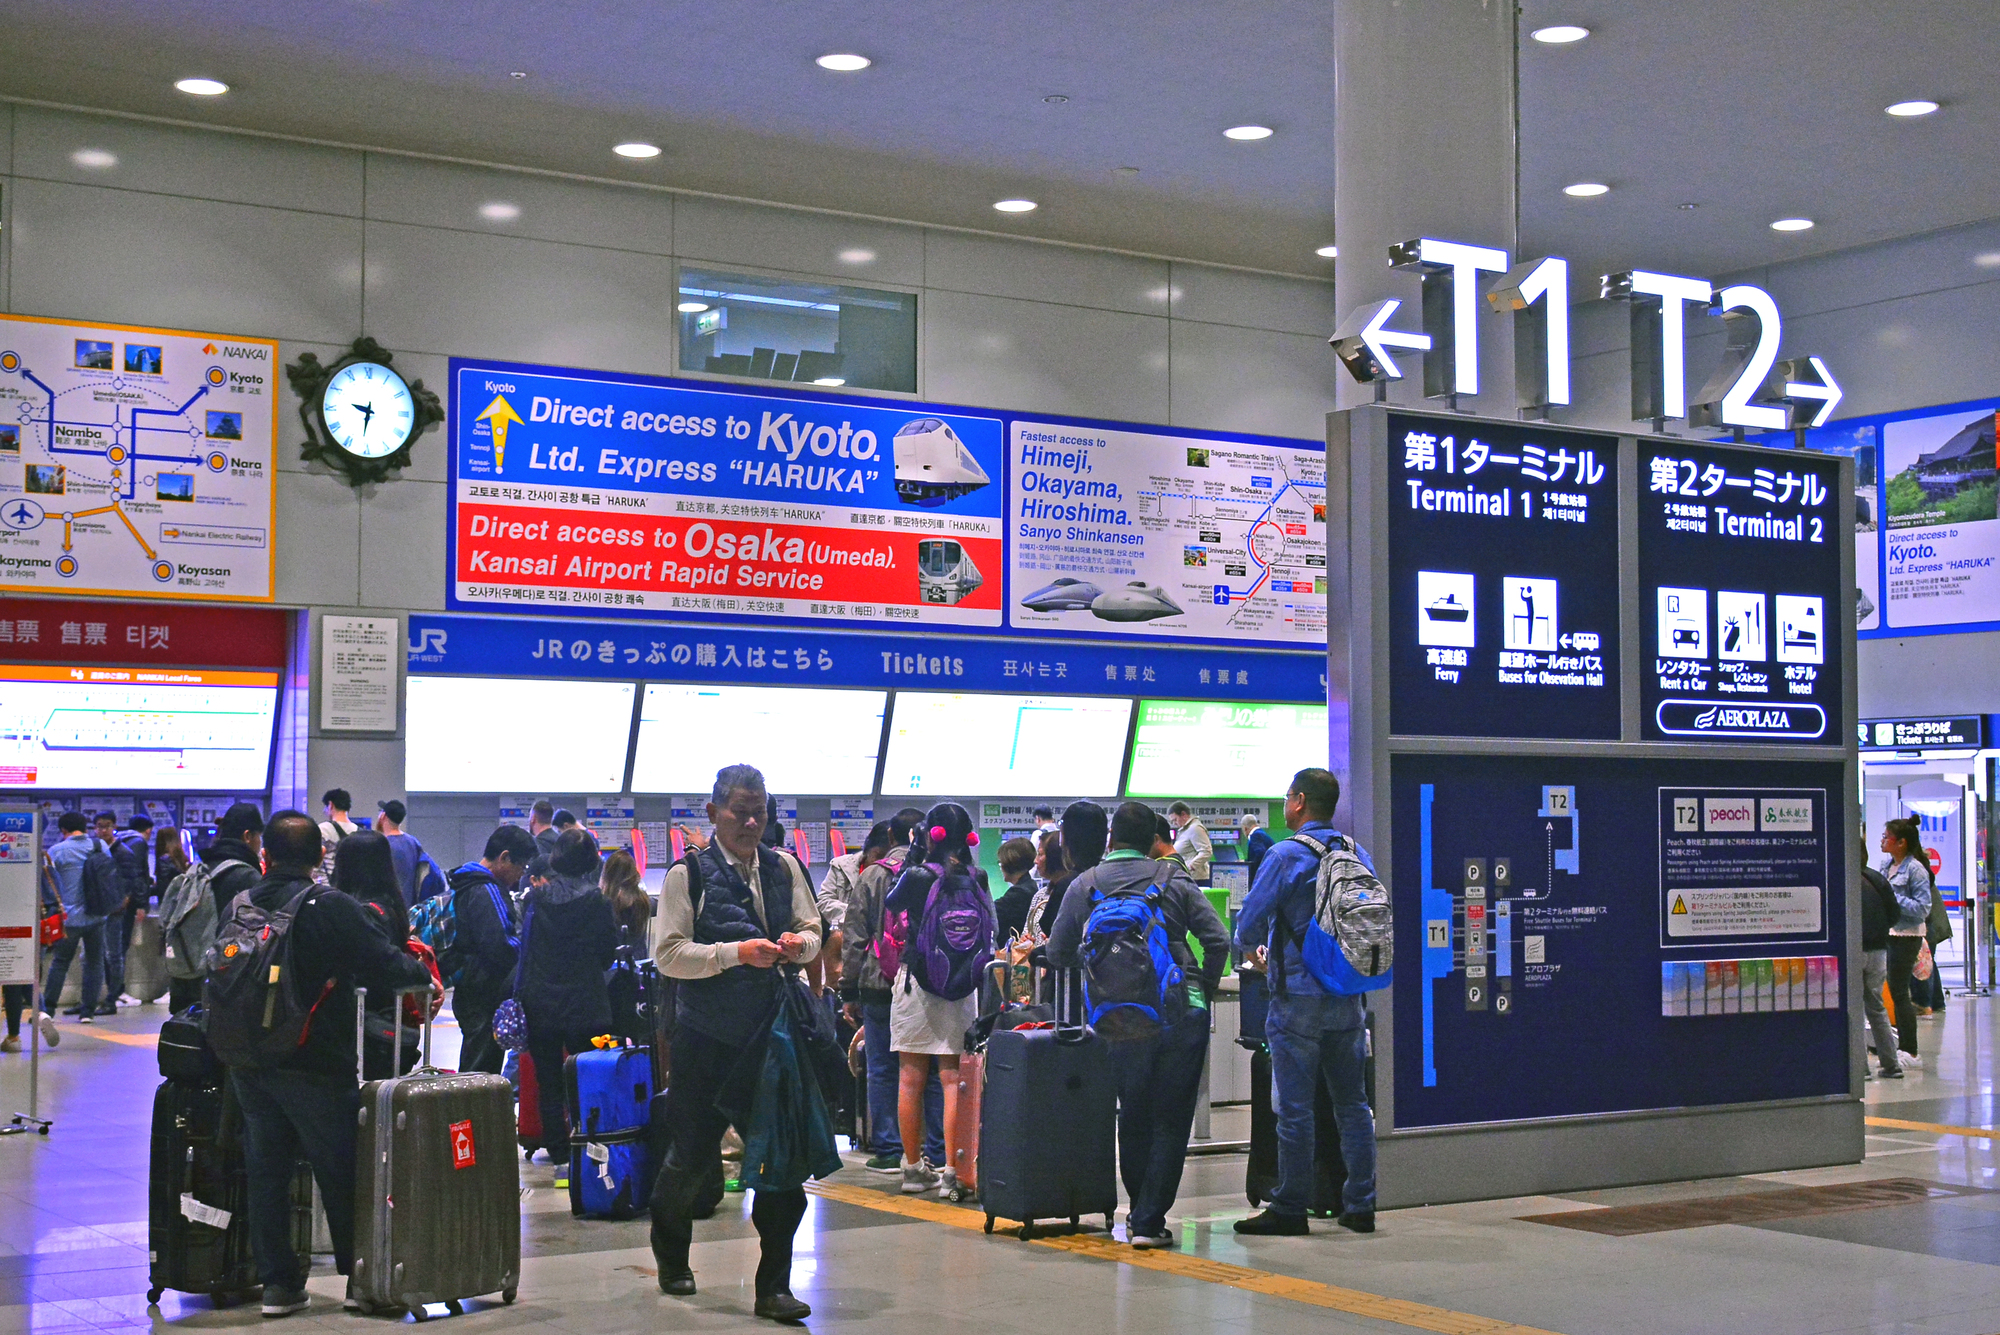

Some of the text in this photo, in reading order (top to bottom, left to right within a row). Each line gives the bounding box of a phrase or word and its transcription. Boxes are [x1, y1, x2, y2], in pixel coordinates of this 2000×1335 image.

[1419, 238, 1570, 406] T1
[223, 347, 267, 360] NANKAI
[1632, 270, 1787, 430] T2
[230, 372, 263, 384] Kyoto
[485, 381, 515, 394] Kyoto
[56, 426, 101, 438] Namba
[530, 396, 880, 461] Direct access to Kyoto.
[1021, 431, 1106, 447] Fastest access to
[470, 444, 490, 452] Tennoji
[1234, 452, 1259, 460] Romantic
[231, 458, 262, 469] Nara
[1021, 445, 1092, 473] Himeji,
[1404, 431, 1604, 485] 第1ターミナル
[529, 444, 878, 493] Ltd. Express "HARUKA"
[1301, 469, 1316, 477] Kyoto
[1021, 471, 1122, 502] Okayama,
[1650, 456, 1826, 505] 第2ターミナル
[469, 487, 499, 497] 교토로
[502, 488, 525, 499] 직결.
[527, 490, 556, 502] 간사이
[560, 492, 579, 503] 공항
[582, 493, 600, 505] 특급
[1230, 486, 1262, 495] Shin-Osaka
[1407, 479, 1531, 518] Terminal 1
[1021, 498, 1132, 525] Hiroshima.
[1543, 508, 1585, 522] 제1터미널
[1888, 513, 1924, 522] Kiyomizudera
[470, 515, 549, 540] Direct
[558, 524, 644, 546] access
[654, 528, 677, 548] to
[1666, 519, 1706, 533] 제2터미널
[1714, 507, 1823, 542] Terminal 2
[236, 534, 262, 542] Railway
[1019, 524, 1144, 545] Sanyo Shinkansen
[1287, 538, 1321, 546] Osakajokoen
[1889, 529, 1958, 543] Direct access to
[1208, 548, 1246, 557] Universal-City
[1890, 544, 1936, 564] Kyoto.
[178, 565, 230, 577] Koyasan
[470, 550, 824, 590] Kansai Airport Rapid Service
[1890, 557, 1995, 575] Ltd. Express "HARUKA"
[548, 590, 570, 601] 직결.
[573, 592, 601, 604] 간사이
[604, 594, 623, 604] 공항
[626, 594, 644, 605] 쾌속
[60, 621, 108, 646] 售票
[126, 625, 170, 650] 티켓
[408, 628, 447, 654] JR
[881, 651, 964, 676] Tickets
[1427, 648, 1468, 666] 高速船
[1499, 652, 1602, 671] 展望ホール行きバス
[1104, 664, 1156, 683] 售票处
[1199, 667, 1249, 685] 售票處
[1435, 667, 1459, 684] Ferry
[1656, 659, 1711, 676] レンタカー
[1785, 666, 1816, 681] ホテル
[1499, 670, 1522, 683] Buses
[1524, 671, 1537, 684] for
[1586, 673, 1603, 686] Hall
[1660, 677, 1707, 690] Rent a Car
[1734, 670, 1767, 683] レストラン
[1789, 682, 1812, 694] Hotel
[1716, 709, 1790, 728] AEROPLAZA
[1896, 736, 1922, 744] Tickets
[1550, 795, 1567, 809] T2
[1676, 807, 1696, 824] T2
[1709, 806, 1750, 824] peach
[1429, 925, 1446, 942] T1
[1525, 964, 1561, 973] エアロプラザ
